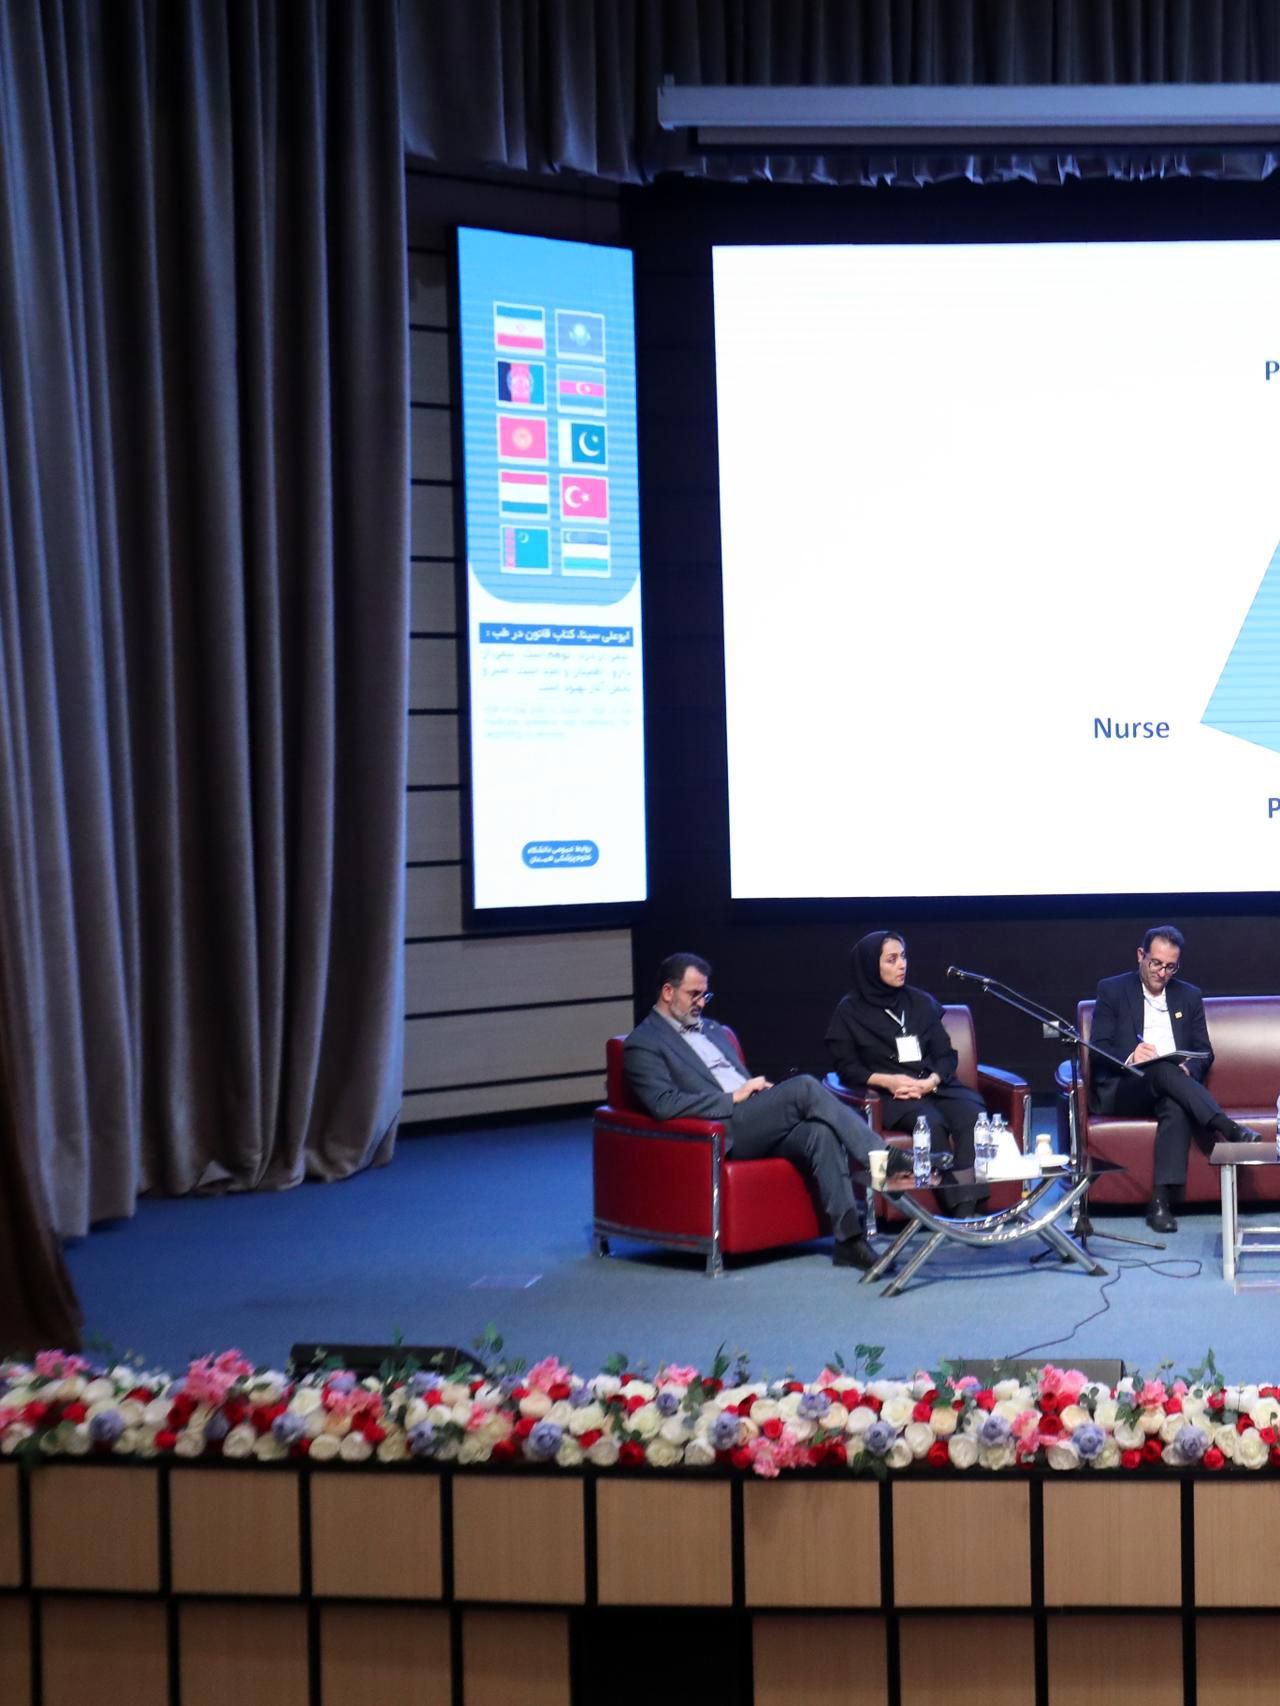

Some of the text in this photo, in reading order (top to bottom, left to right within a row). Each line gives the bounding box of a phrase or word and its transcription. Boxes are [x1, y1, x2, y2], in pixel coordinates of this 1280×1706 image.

[491, 627, 510, 638] طب
[511, 629, 524, 640] در
[525, 628, 551, 641] قانون
[552, 629, 575, 642] کتاب
[1094, 718, 1169, 739] Nurse
